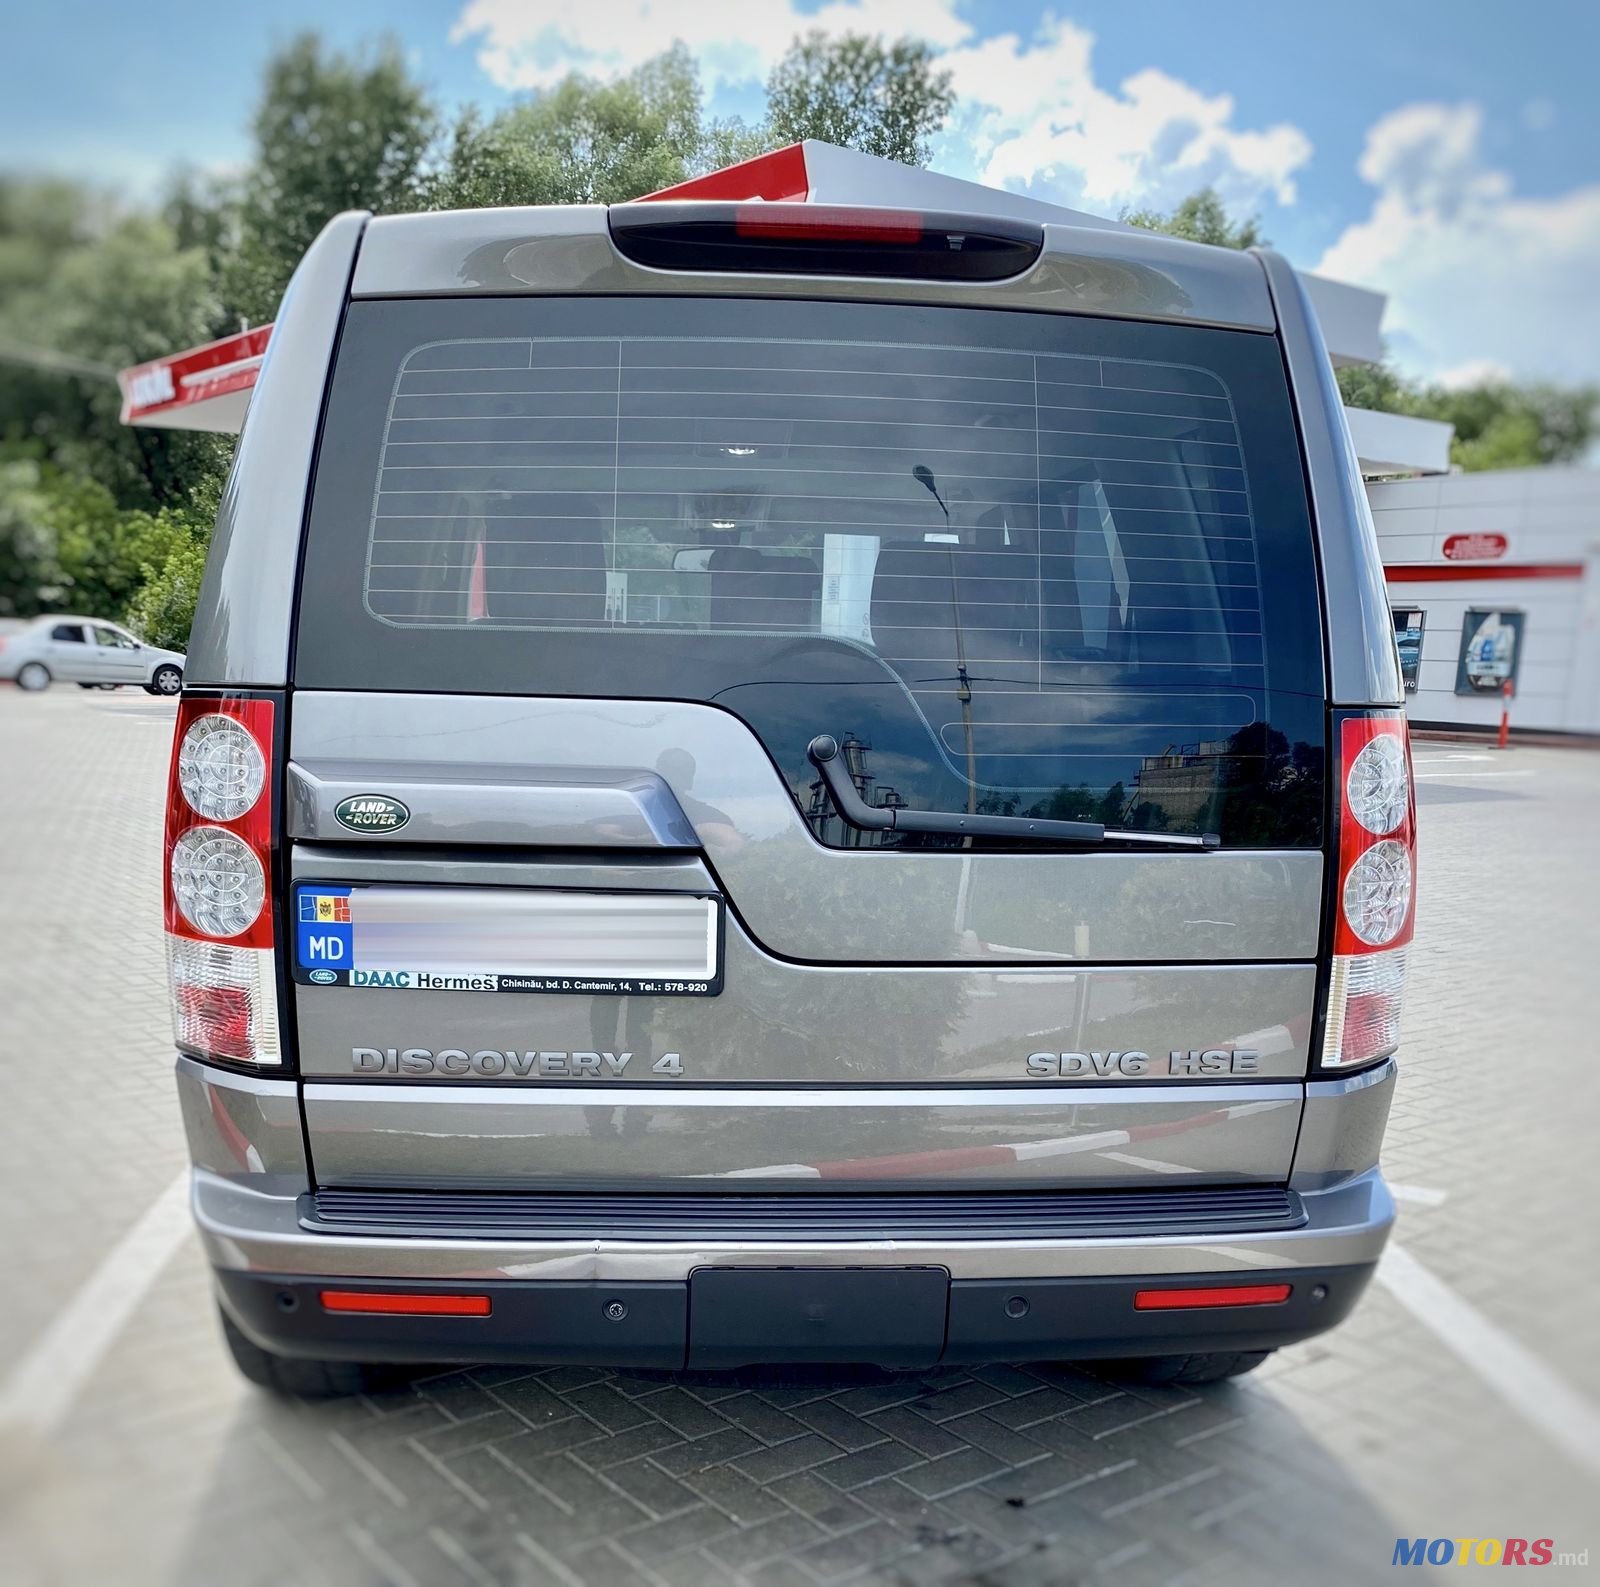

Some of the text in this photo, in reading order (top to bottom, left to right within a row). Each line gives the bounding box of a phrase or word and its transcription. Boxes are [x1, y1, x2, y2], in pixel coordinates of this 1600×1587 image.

[350, 802, 386, 813] LAND
[353, 813, 397, 825] ROVER
[309, 935, 344, 961] MD
[353, 970, 496, 990] DAAC Hermes
[546, 980, 561, 989] bd.
[562, 981, 572, 989] D.
[574, 981, 617, 991] Cantemir,
[619, 982, 632, 991] 14,
[638, 982, 661, 991] Tel.:
[664, 982, 708, 992] 578-920
[351, 1047, 685, 1077] DISCOVERY 4
[1026, 1049, 1259, 1077] SDV6 HSE
